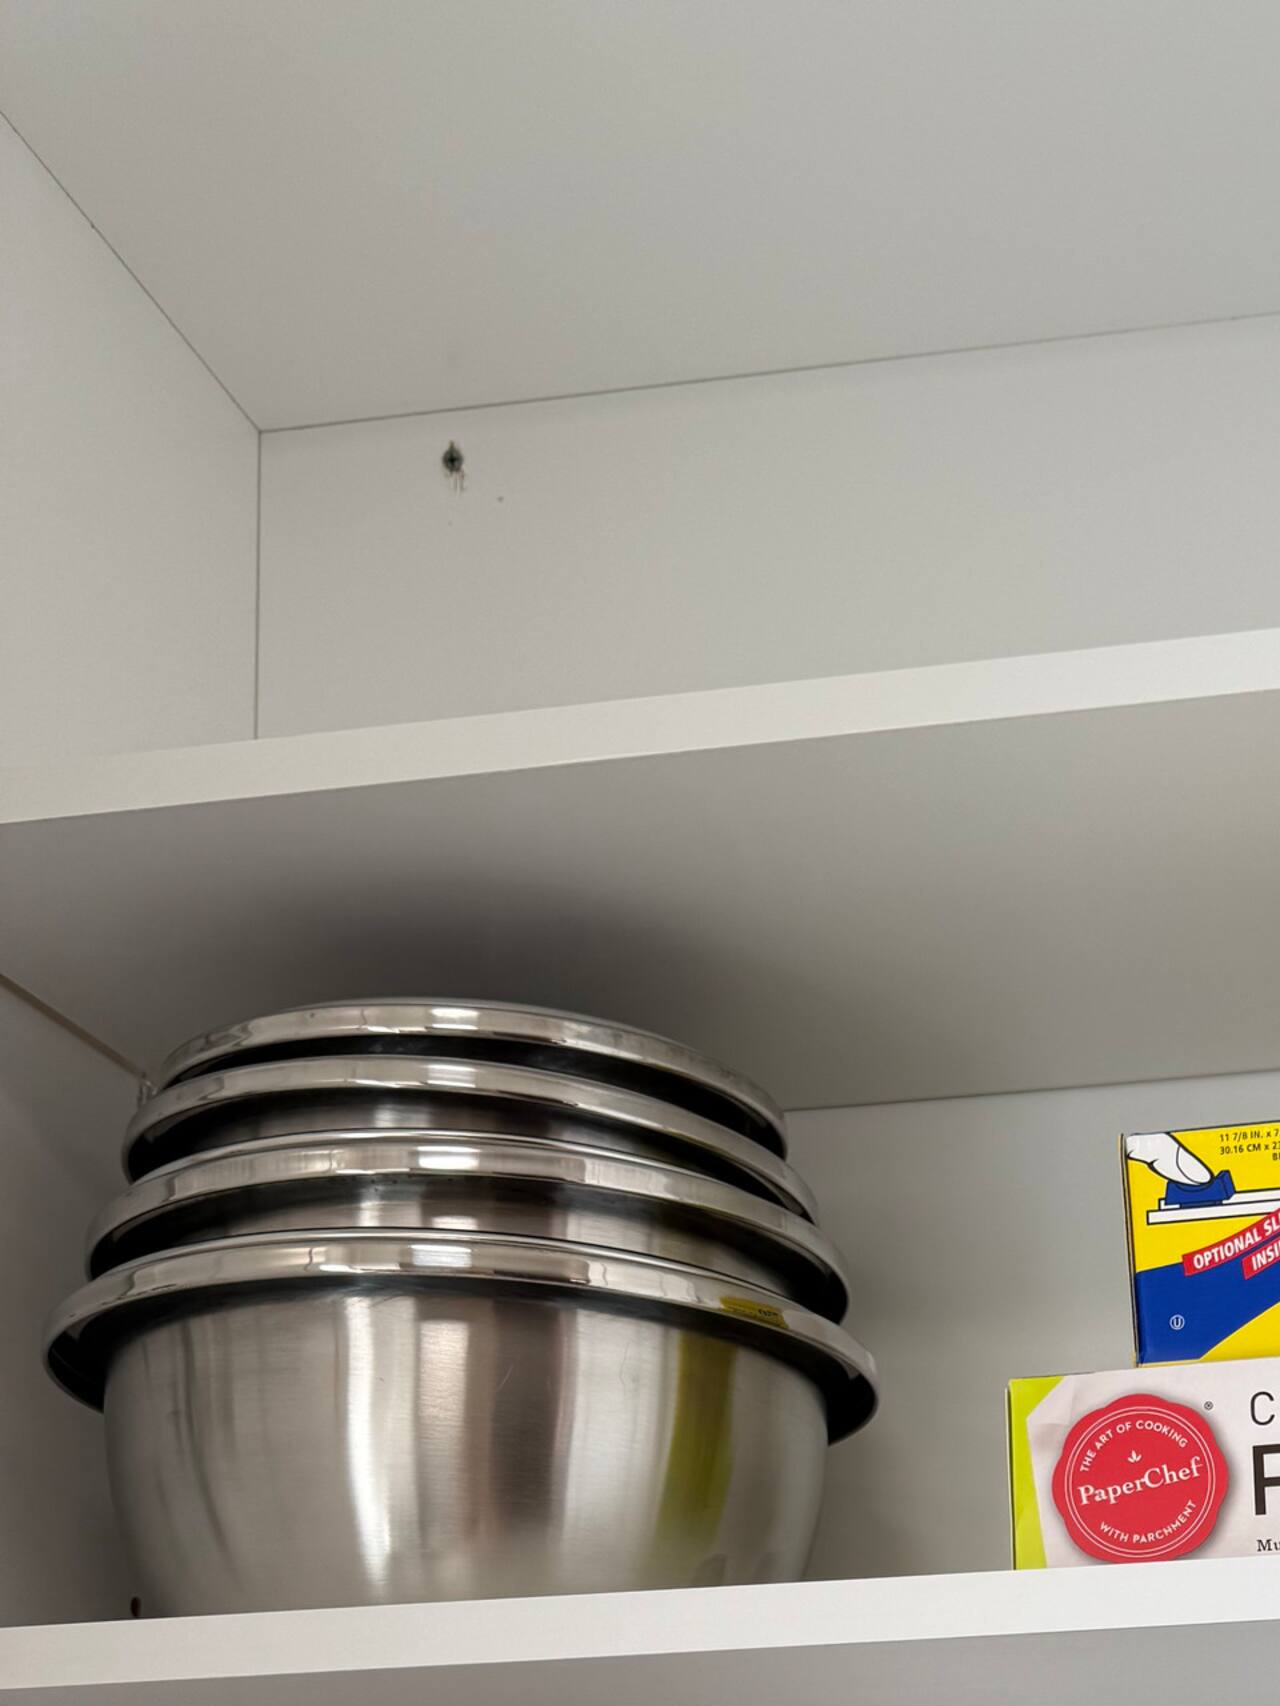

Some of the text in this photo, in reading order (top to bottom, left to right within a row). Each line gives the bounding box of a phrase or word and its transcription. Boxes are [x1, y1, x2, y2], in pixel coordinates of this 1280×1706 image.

[1220, 1133, 1229, 1142] 11
[1232, 1131, 1248, 1141] 7/8
[1250, 1130, 1264, 1139] IN.
[1220, 1144, 1244, 1155] 30.16
[1246, 1142, 1261, 1152] CM
[1193, 1232, 1262, 1270] OPTIONAL
[1080, 1420, 1189, 1472] THE ART OF COOKING
[1077, 1456, 1203, 1505] PaperChef
[1100, 1500, 1197, 1544] WITH PARCHMENT
